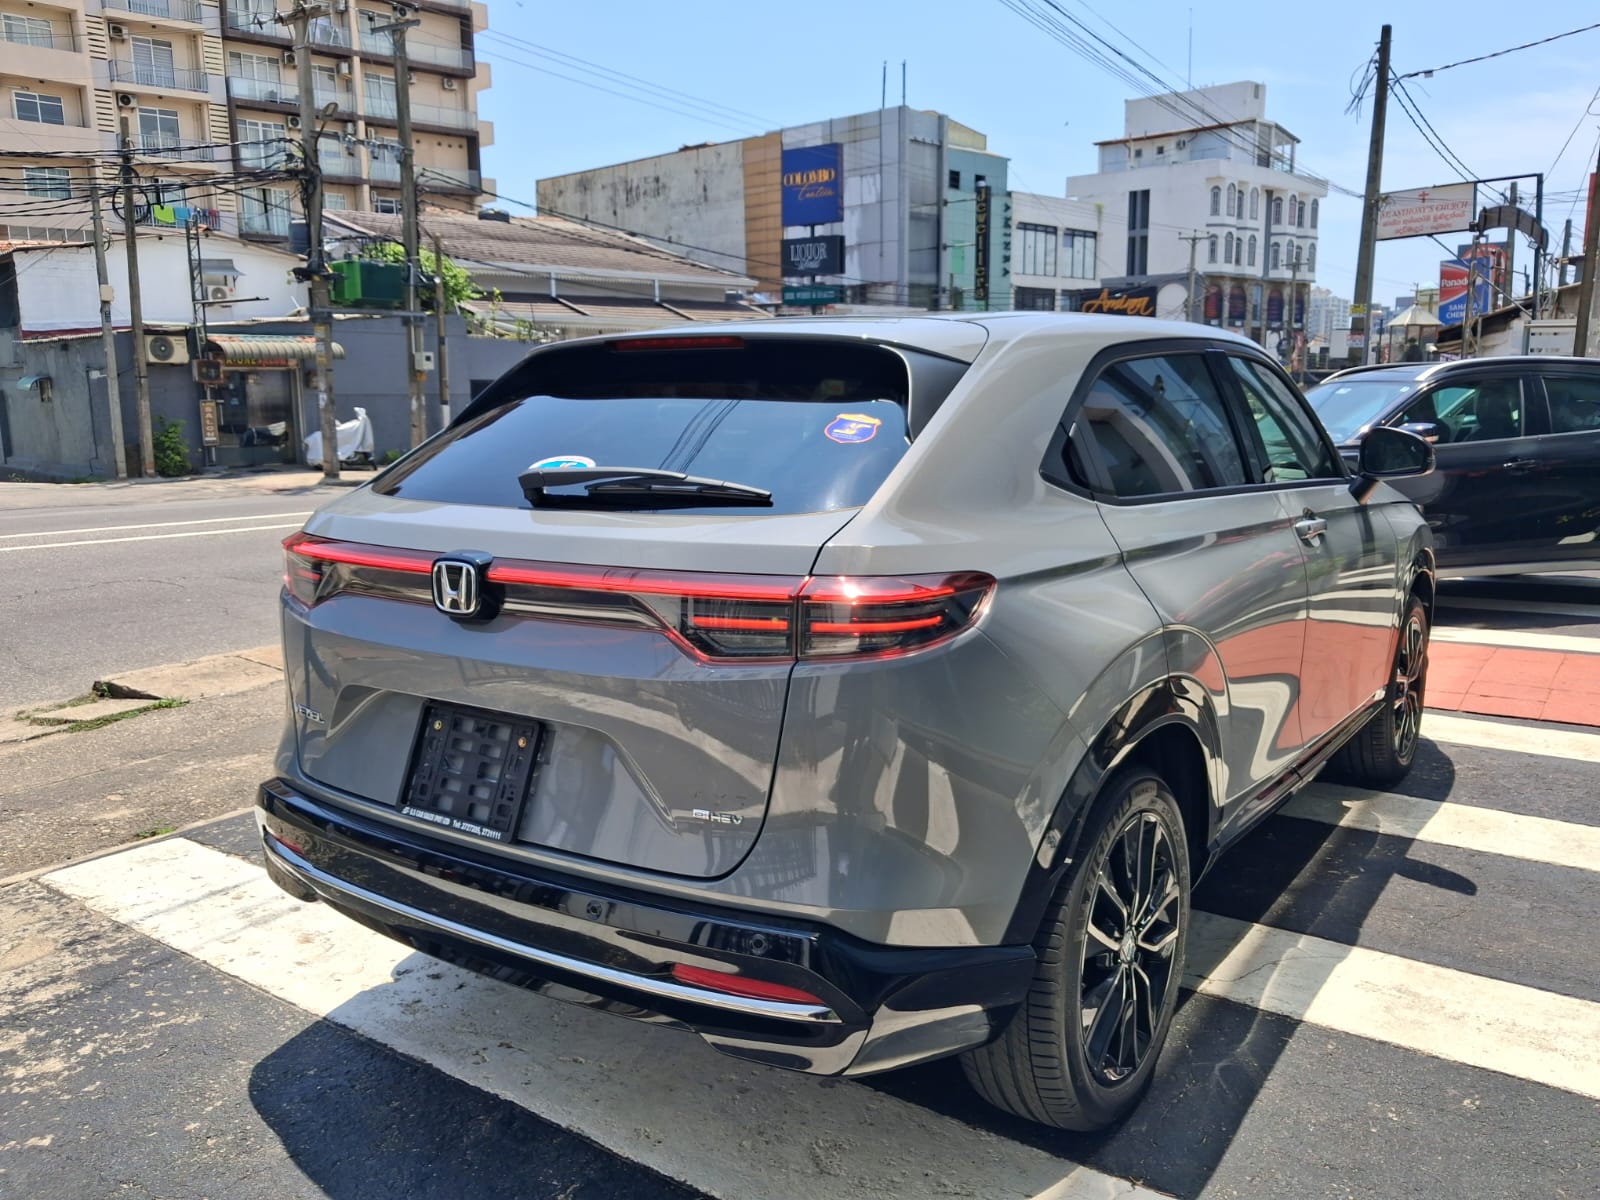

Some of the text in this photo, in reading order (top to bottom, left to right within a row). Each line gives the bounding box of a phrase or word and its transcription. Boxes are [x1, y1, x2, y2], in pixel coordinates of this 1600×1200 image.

[784, 168, 835, 187] COLOMBO
[790, 243, 827, 261] LIQUOR
[1441, 276, 1470, 288] Panad
[1446, 310, 1477, 319] CHEMT
